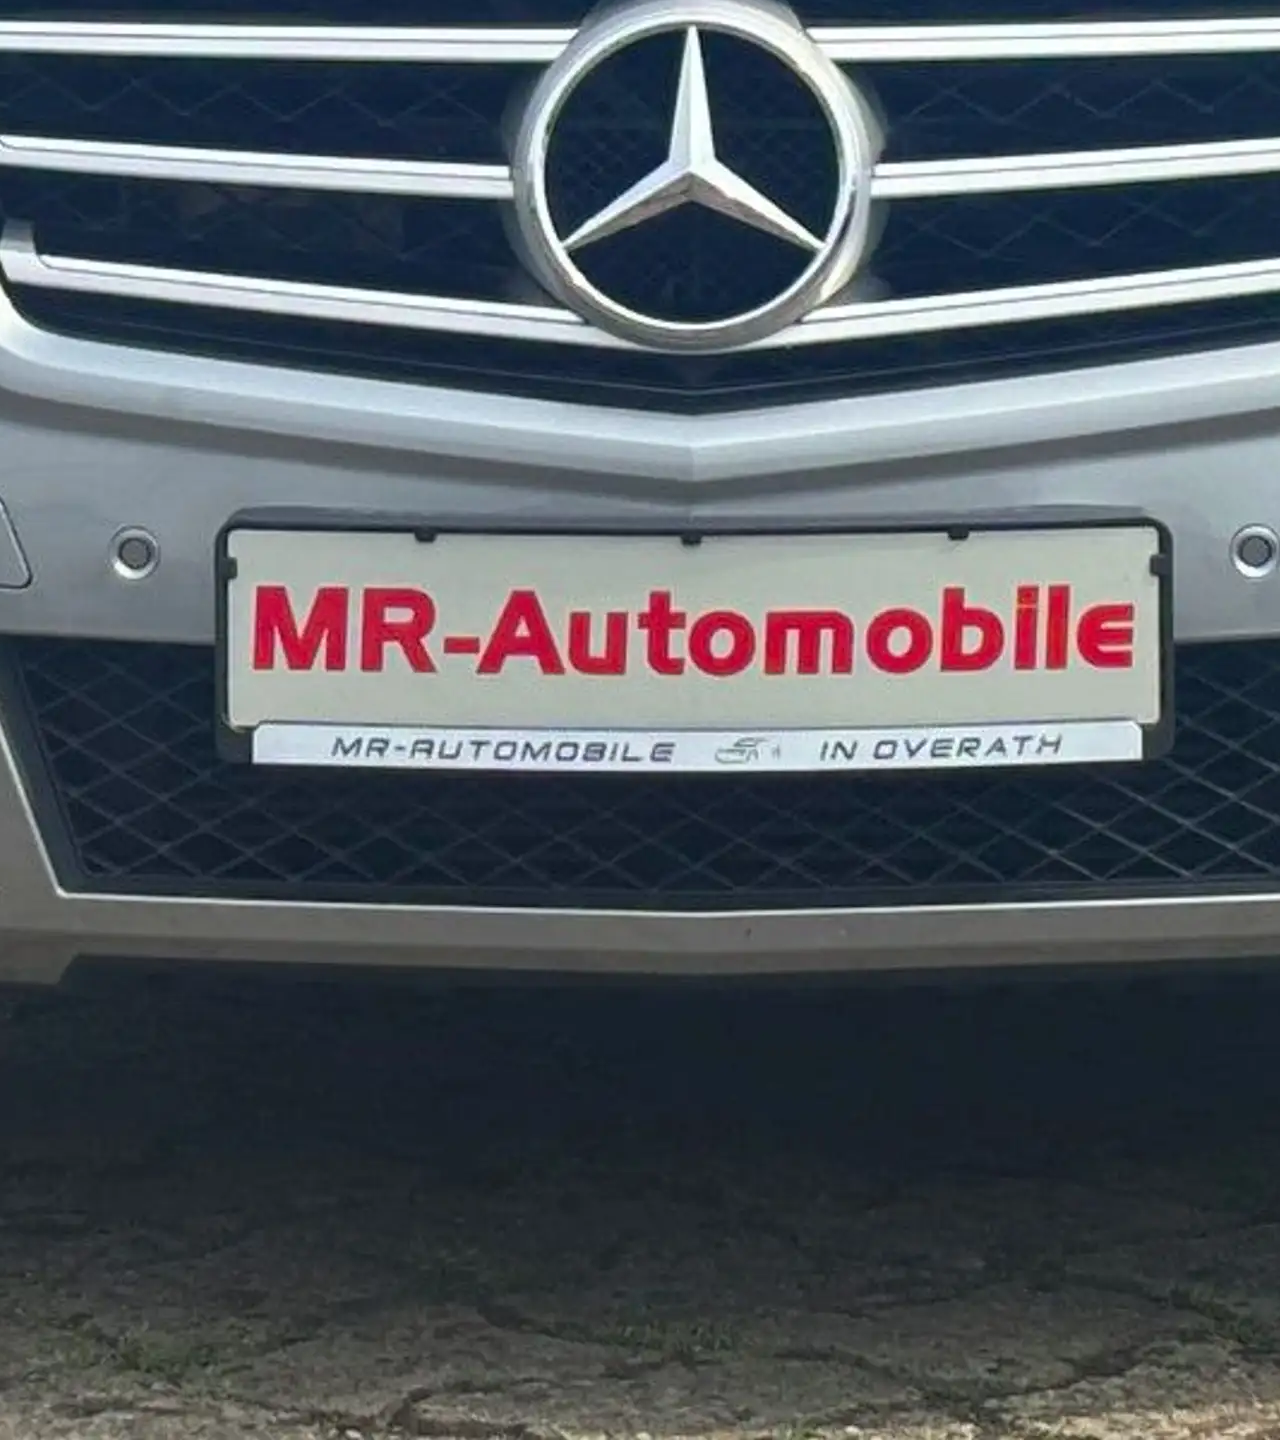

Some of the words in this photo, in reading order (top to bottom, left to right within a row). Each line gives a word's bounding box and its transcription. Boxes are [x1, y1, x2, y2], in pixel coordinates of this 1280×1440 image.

[251, 582, 1136, 676] MR-Automobile
[330, 736, 676, 762] MR-AUTOMOBILE
[819, 740, 858, 761] IN
[872, 734, 1064, 761] OVERATH
